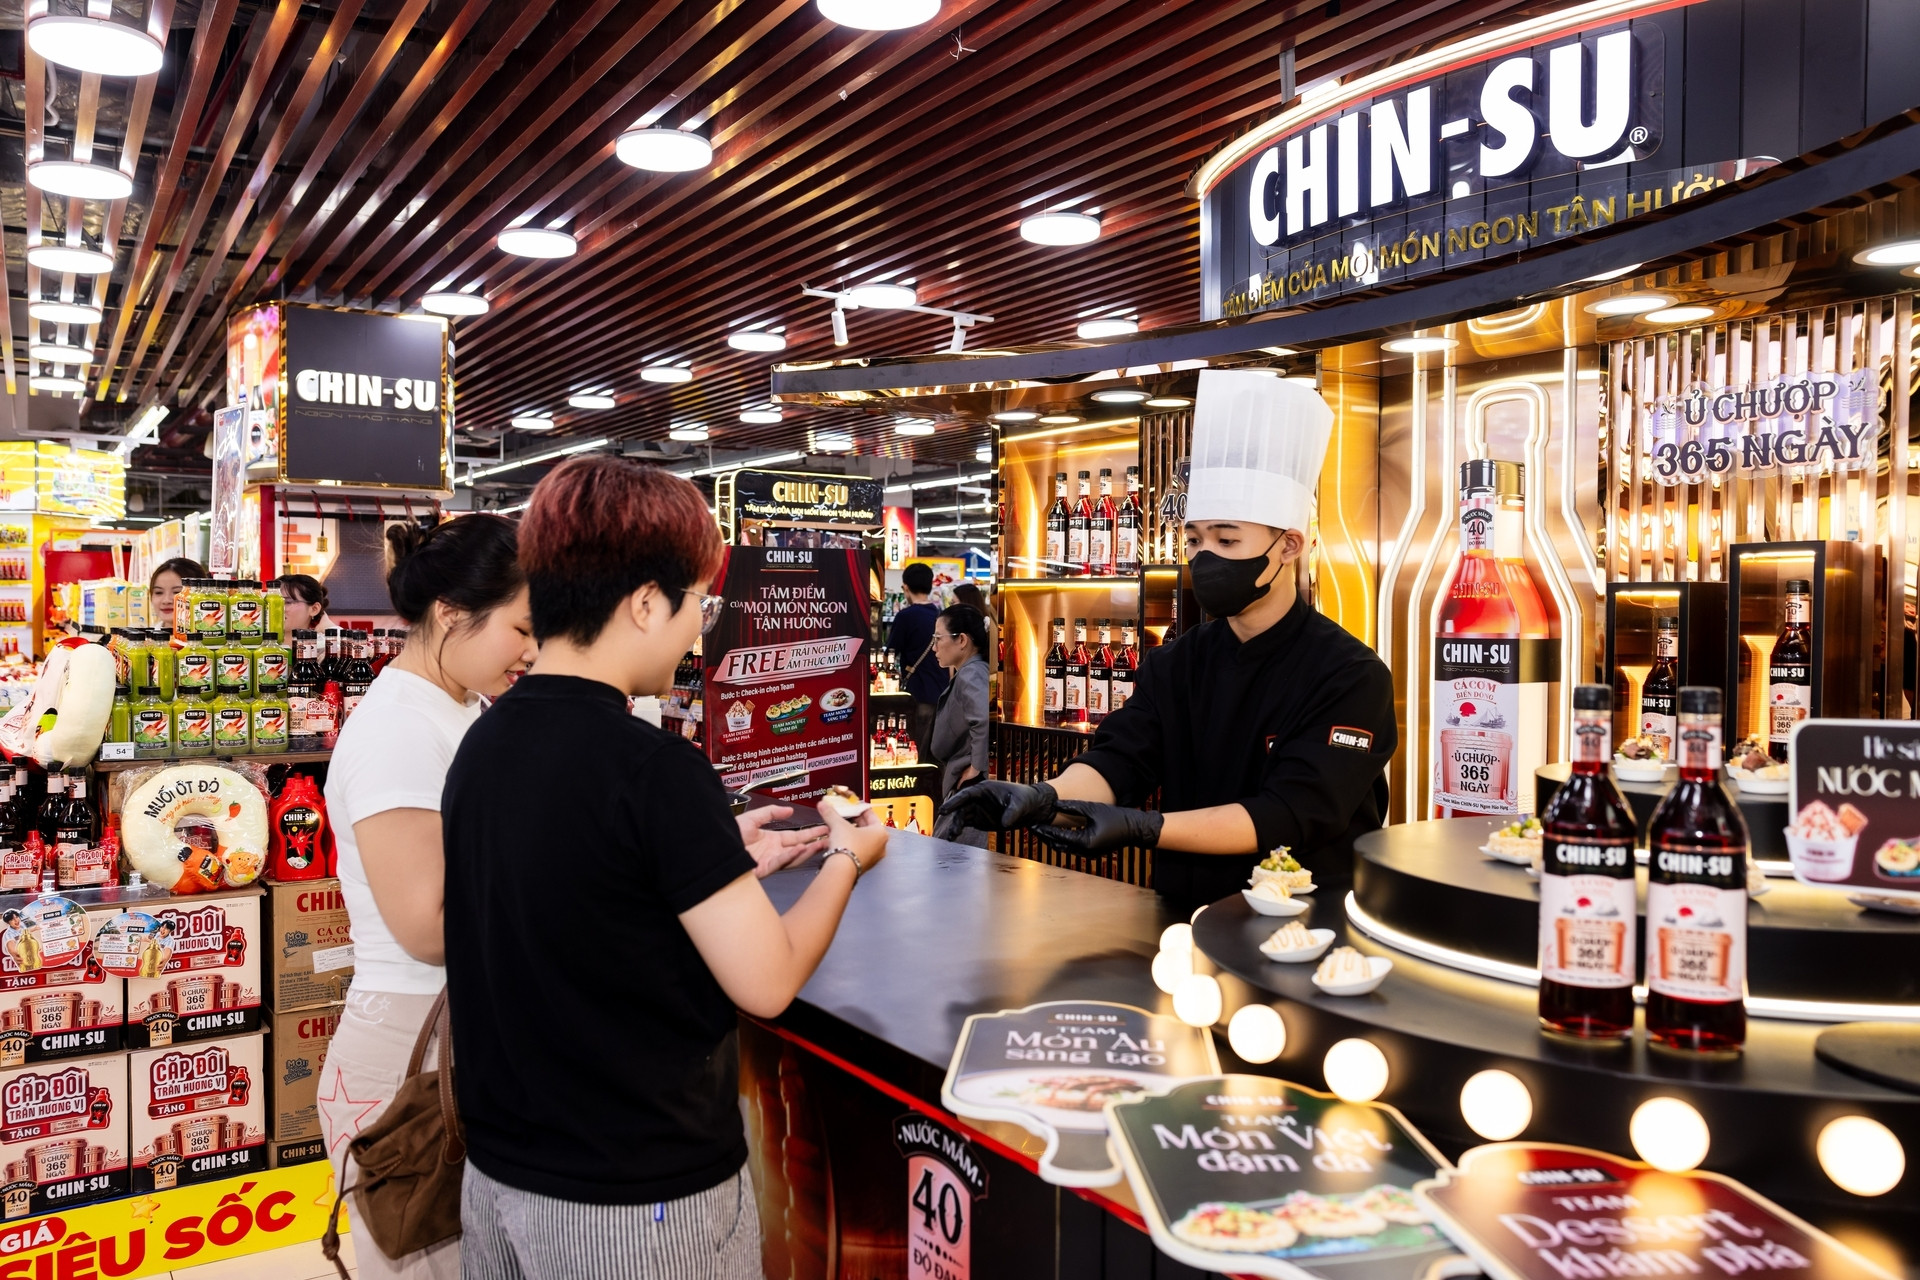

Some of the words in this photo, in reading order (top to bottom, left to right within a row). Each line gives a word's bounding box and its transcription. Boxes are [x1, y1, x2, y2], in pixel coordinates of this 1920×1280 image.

[1288, 262, 1327, 296] CỦA
[1331, 249, 1375, 283] MỌI
[1379, 230, 1441, 271] MÓN
[1447, 211, 1540, 255] NGON
[296, 369, 437, 412] CHIN-SU
[1684, 389, 1708, 425] Ủ
[1711, 379, 1838, 422] CHƯỢP
[1656, 436, 1733, 478] 365
[1740, 416, 1870, 470] NGÀY
[772, 481, 849, 506] CHIN-SU
[1161, 493, 1188, 521] 40
[1468, 520, 1485, 536] 40
[766, 551, 813, 563] CHIN-SU
[760, 585, 790, 599] TÂM
[792, 583, 826, 599] ĐIỂM
[744, 601, 771, 616] MỌI
[774, 599, 807, 614] MÓN
[809, 602, 848, 614] NGON
[754, 615, 781, 632] TẬN
[784, 613, 832, 630] HƯỞNG
[728, 649, 787, 677] FREE
[1443, 643, 1511, 665] CHIN-SU
[1332, 732, 1369, 748] CHIN-SU
[1460, 764, 1490, 781] 365
[1460, 780, 1490, 793] NGÀY
[1556, 843, 1627, 867] CHIN-SU
[1657, 851, 1733, 876] CHIN-SU
[192, 909, 220, 933] ĐÔI
[179, 938, 210, 950] HƯƠNG
[5, 977, 37, 988] TẶNG
[186, 995, 205, 1004] 365
[41, 1013, 62, 1022] 365
[151, 1020, 171, 1033] 40
[187, 1011, 245, 1031] CHIN-SU
[2, 1039, 23, 1053] 40
[41, 1030, 105, 1051] CHIN-SU
[1005, 1031, 1099, 1050] Món
[1004, 1047, 1092, 1065] sáng
[156, 1056, 190, 1084] CẶP
[196, 1052, 225, 1076] ĐÔI
[10, 1078, 46, 1107] CẶP
[53, 1074, 86, 1098] ĐÔI
[184, 1079, 213, 1093] HƯƠNG
[39, 1101, 71, 1116] HƯƠNG
[158, 1103, 186, 1116] TẶNG
[10, 1127, 41, 1140] TẶNG
[191, 1135, 210, 1146] 365
[1151, 1121, 1275, 1151] Món
[191, 1150, 249, 1172] CHIN-SU
[282, 1144, 322, 1160] CHIN-SU
[902, 1120, 940, 1148] NƯỚC
[942, 1135, 979, 1183] MẮM
[46, 1160, 67, 1172] 365
[156, 1163, 174, 1177] 40
[1198, 1150, 1302, 1176] đậm
[46, 1175, 110, 1199] CHIN-SU
[7, 1190, 28, 1204] 40
[912, 1168, 964, 1245] 40
[163, 1181, 296, 1260] SỐC
[1498, 1208, 1764, 1249] Dessert
[0, 1220, 55, 1253] GIÁ
[1537, 1245, 1703, 1280] khám
